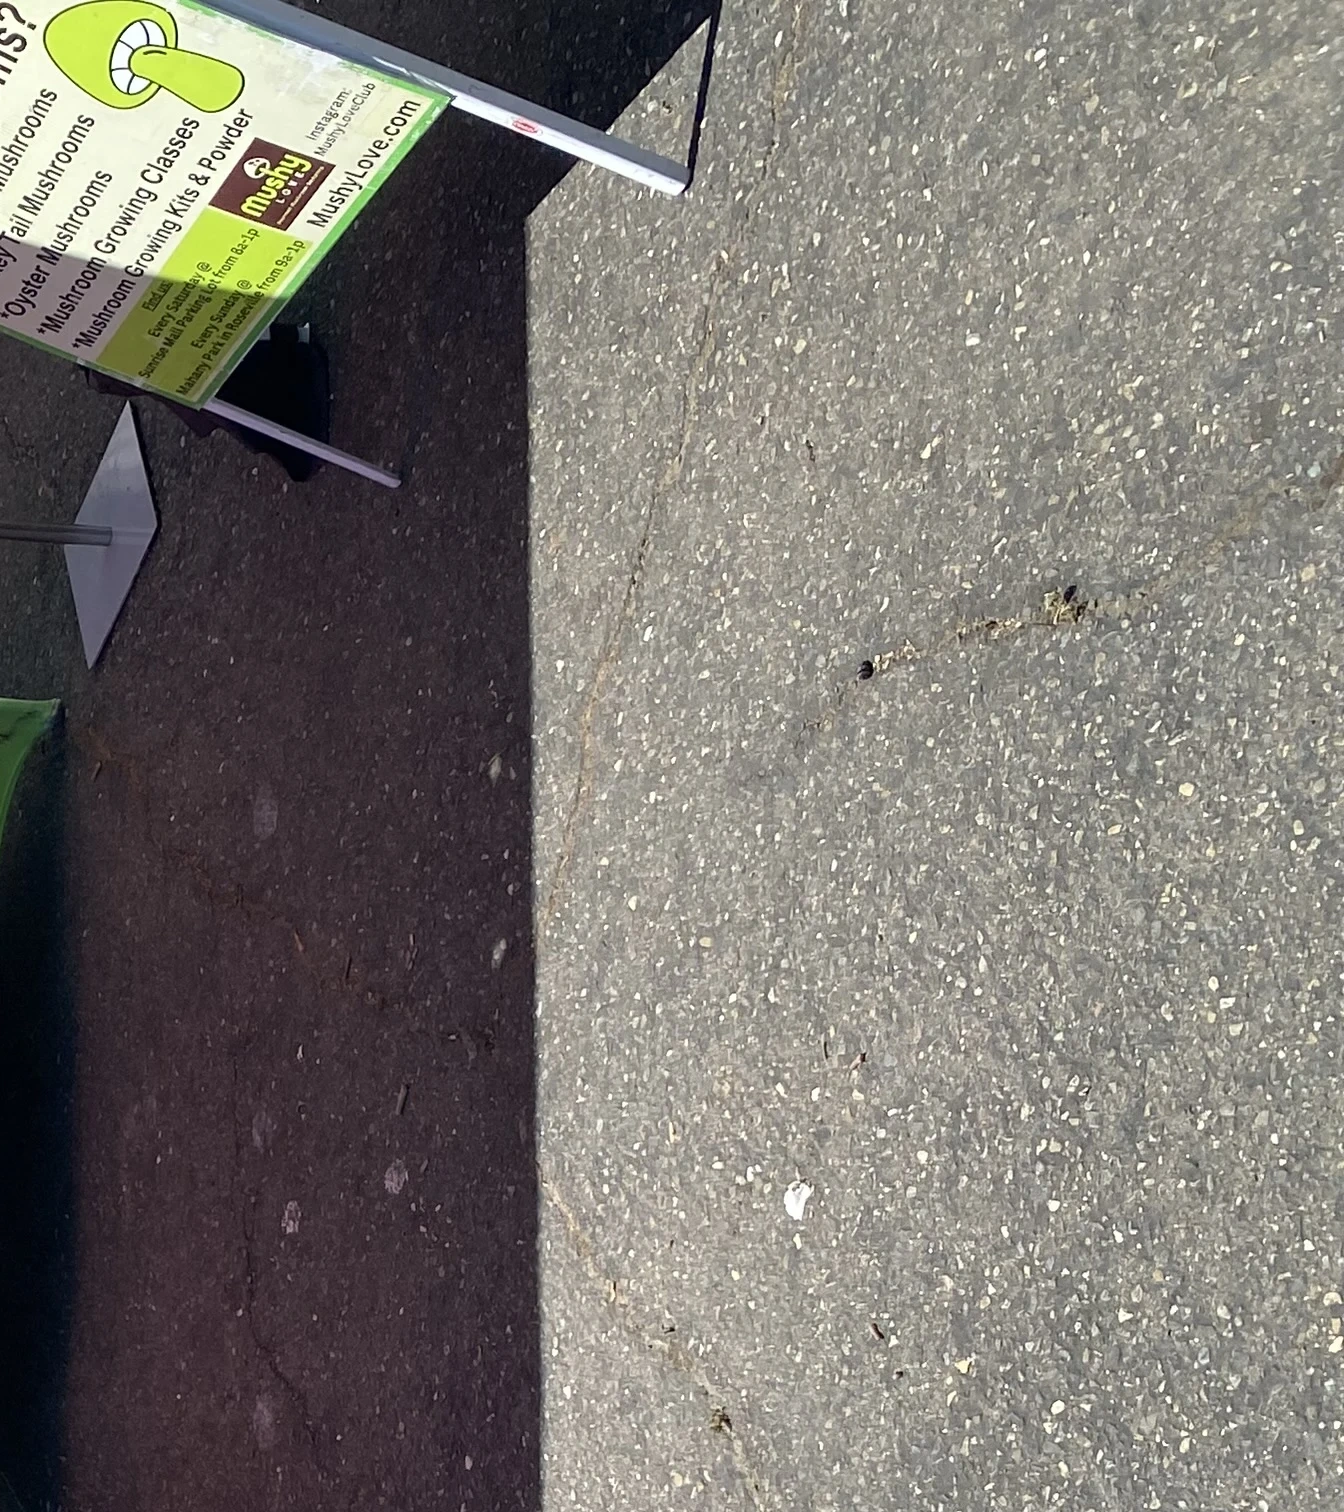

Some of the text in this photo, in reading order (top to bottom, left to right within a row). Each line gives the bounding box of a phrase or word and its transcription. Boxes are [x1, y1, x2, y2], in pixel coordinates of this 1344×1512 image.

[196, 107, 255, 172] Powder
[305, 87, 353, 141] Instagram:
[313, 82, 376, 157] MushyLoveClub
[17, 113, 96, 216] Mushrooms
[93, 186, 159, 254] Growing
[139, 116, 200, 184] Classes
[188, 172, 212, 186] &
[275, 171, 305, 204] LOVE
[306, 99, 421, 228] MushyLove.com
[36, 169, 113, 266] Mushrooms
[164, 186, 202, 218] Kits
[123, 218, 183, 278] Growing
[273, 239, 305, 268] 9a-1p
[137, 227, 260, 379] Sunrise Mall Parking Lot from 8a-1p
[141, 291, 163, 312] Find
[147, 261, 211, 338] Every Saturday @
[256, 263, 284, 291] from
[190, 279, 252, 350] Every Sunday @
[216, 331, 233, 341] in
[224, 291, 265, 331] Roseville
[200, 340, 224, 361] Park
[175, 361, 212, 396] Mahany
